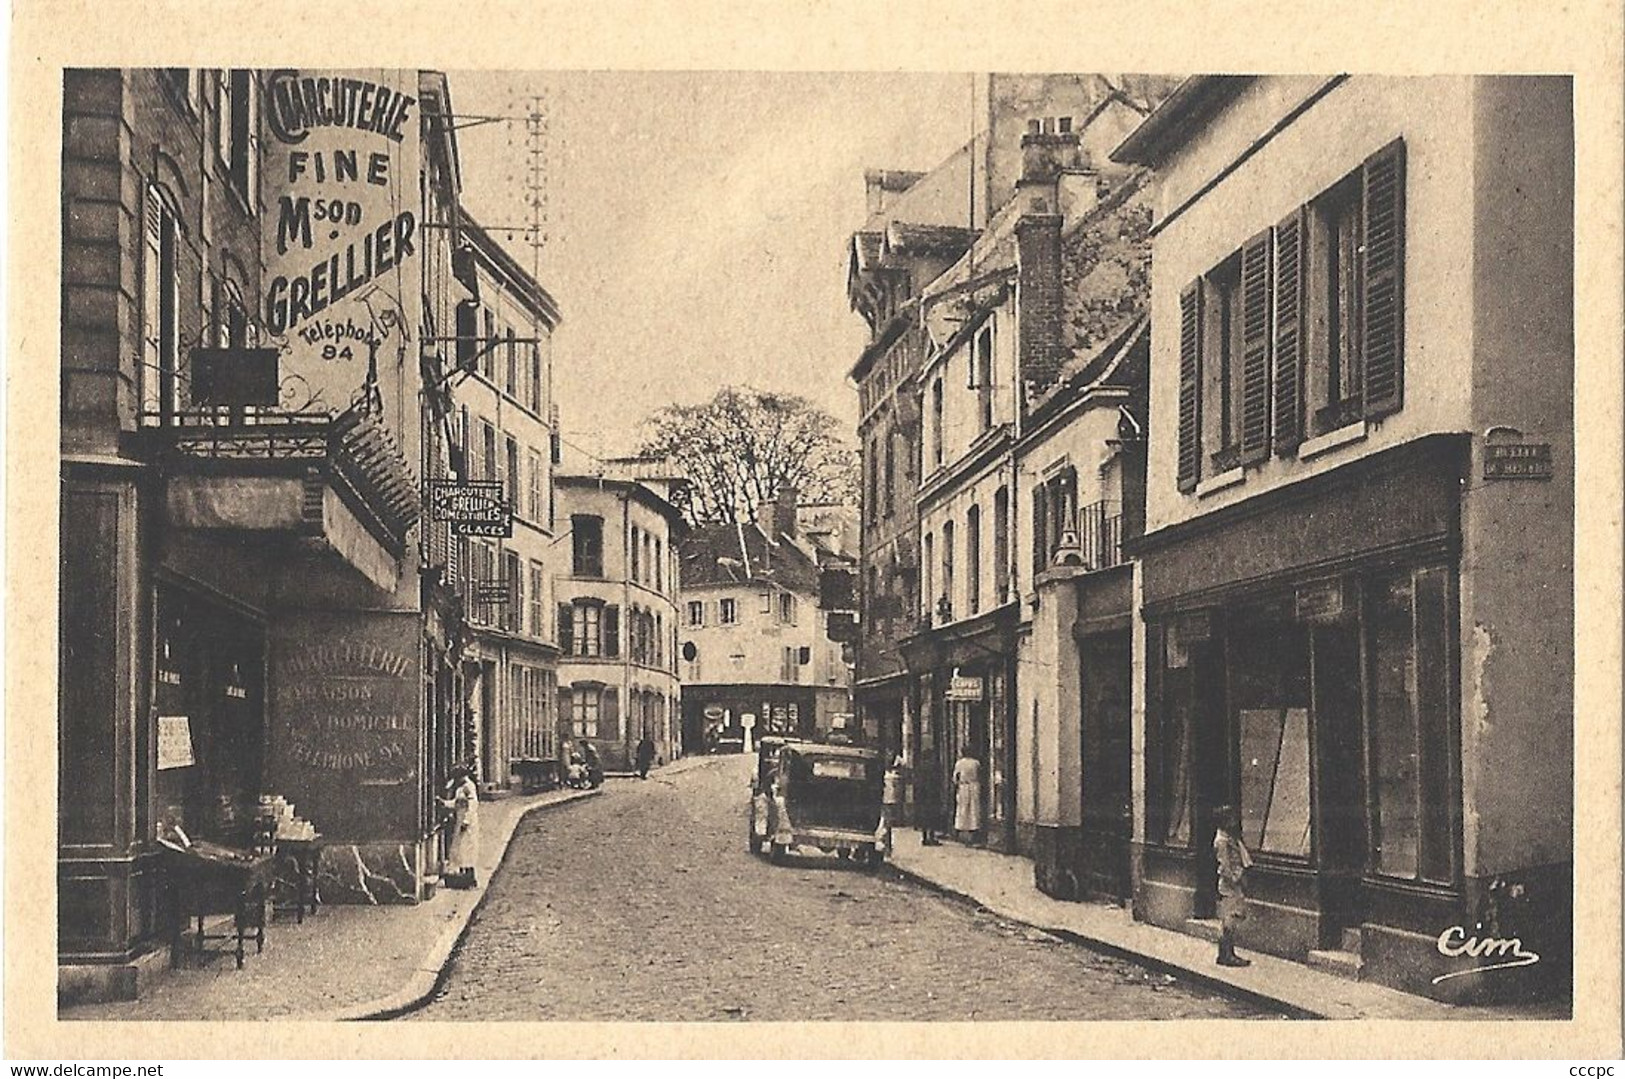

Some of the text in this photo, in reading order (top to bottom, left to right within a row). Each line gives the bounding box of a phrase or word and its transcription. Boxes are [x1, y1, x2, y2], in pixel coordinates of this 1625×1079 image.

[266, 68, 417, 145] CHARCUTERIE
[288, 150, 391, 186] FINE
[266, 211, 416, 337] GRELLIER
[321, 344, 354, 361] 94
[434, 486, 502, 503] CHARCUTERIE
[434, 505, 502, 521] COMESTIBLES
[458, 523, 506, 536] GLACES
